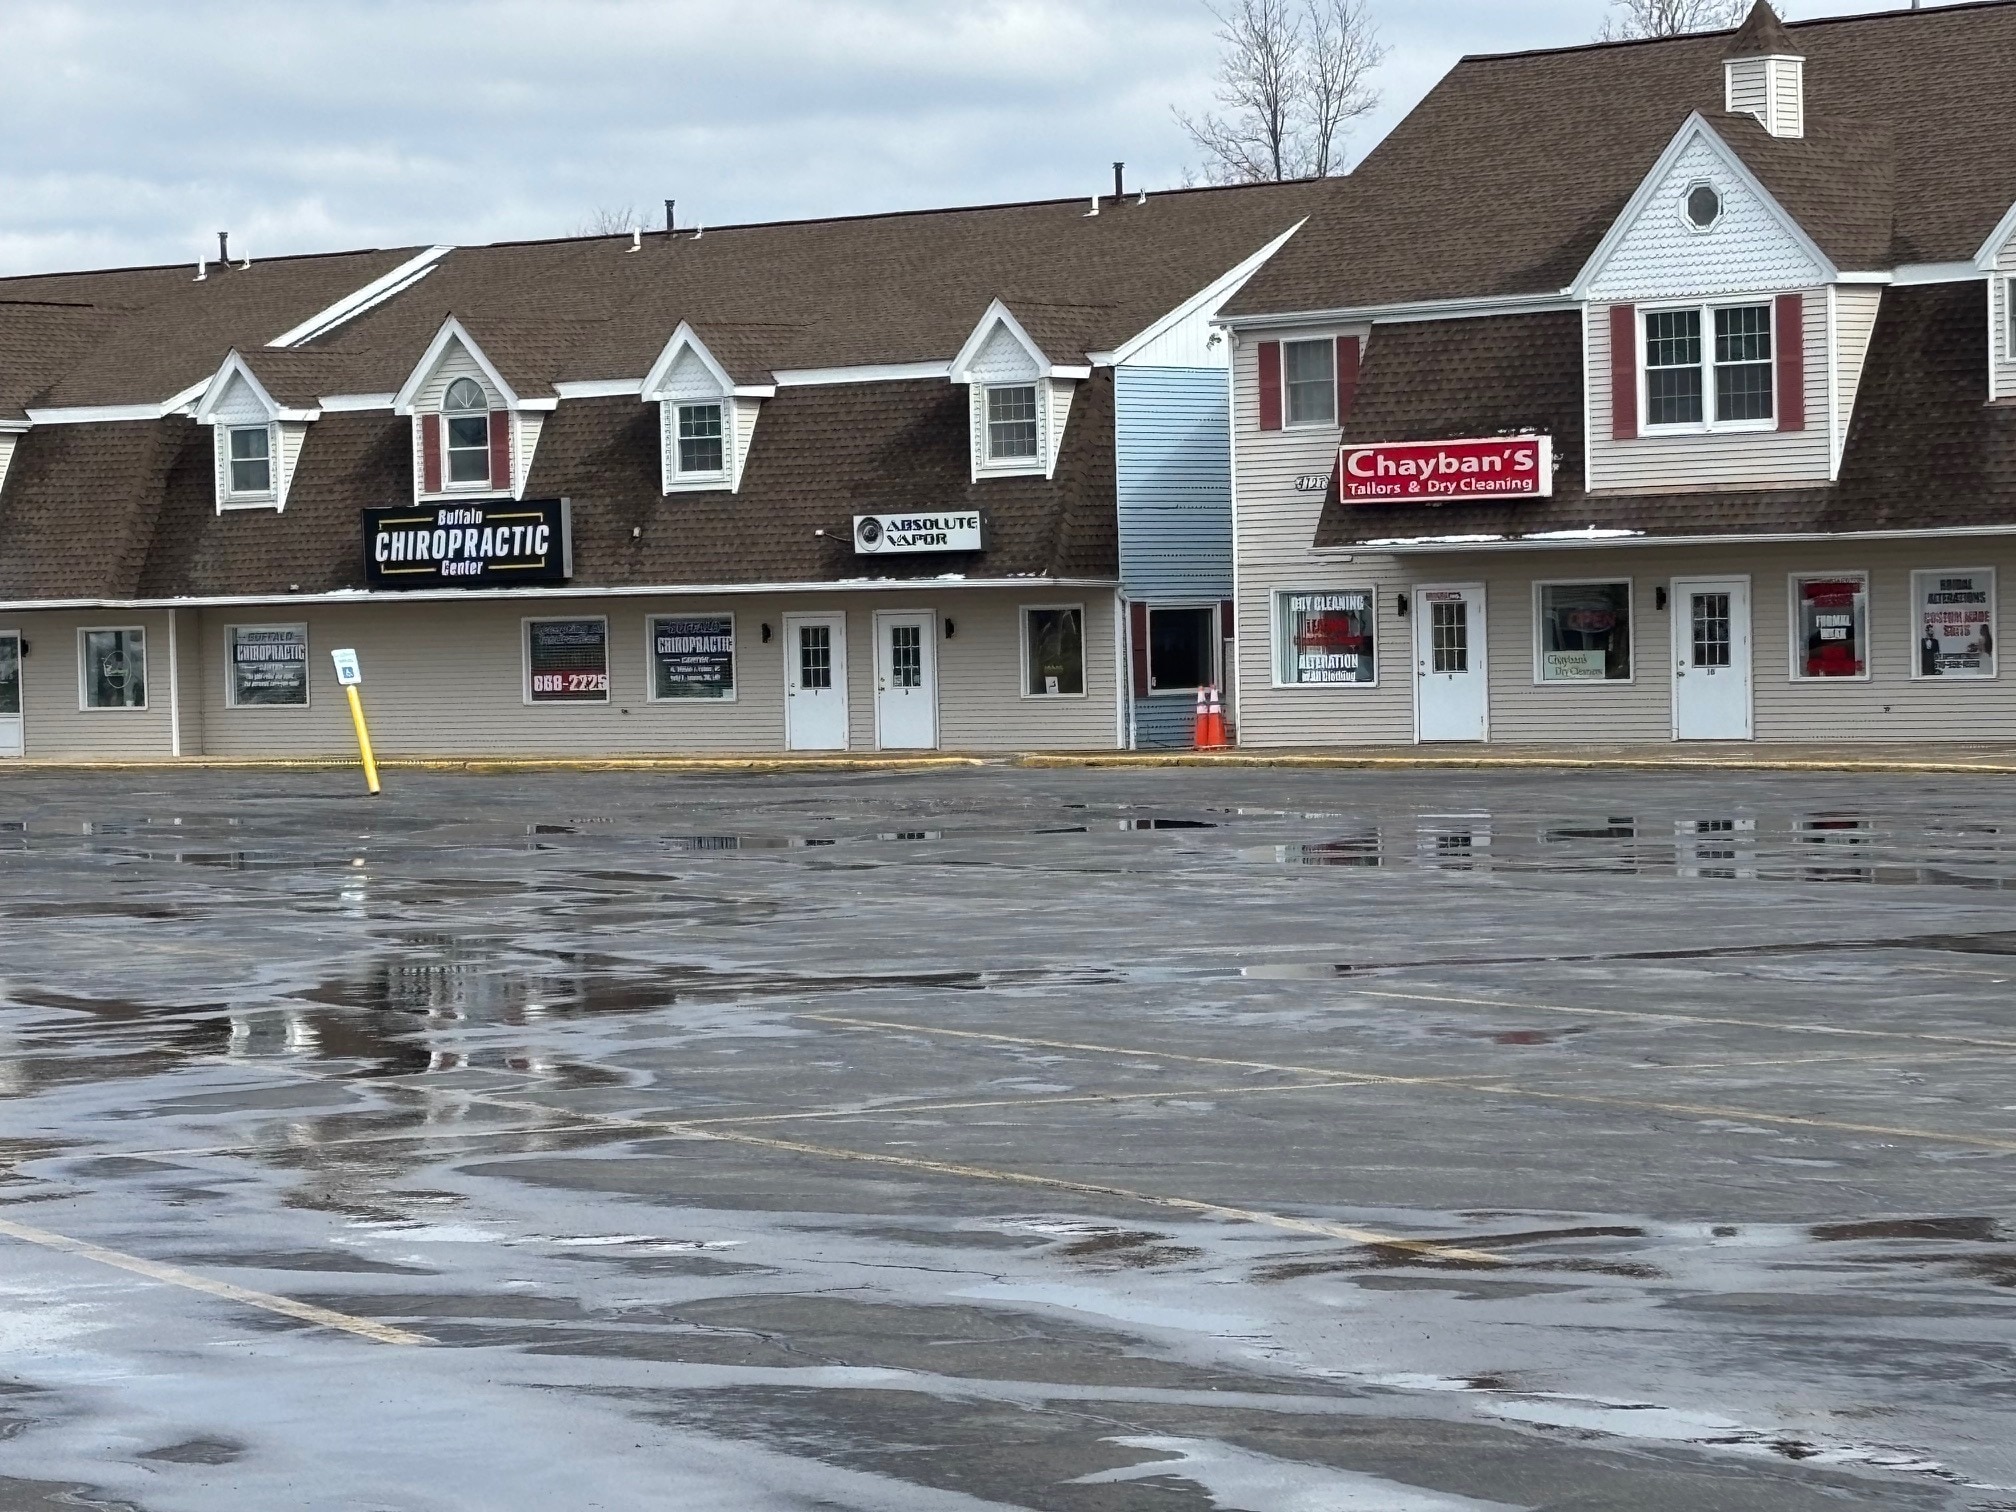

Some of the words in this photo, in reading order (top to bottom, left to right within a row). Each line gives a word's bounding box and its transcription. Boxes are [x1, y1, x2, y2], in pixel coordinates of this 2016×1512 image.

[1348, 481, 1401, 496] Tailors
[1408, 482, 1421, 493] &
[1428, 479, 1457, 496] Dry
[1460, 477, 1533, 492] Cleaning
[437, 507, 483, 526] Buffalo
[885, 516, 978, 532] ABSOLUTE
[374, 524, 550, 562] CHIROPRACTIC
[886, 532, 948, 547] VAPOR
[441, 560, 484, 576] Center
[1314, 595, 1364, 611] CLEANING
[247, 631, 294, 642] BUFFALO
[657, 635, 734, 654] CHIROPRACTIC
[237, 644, 305, 661] CHIROPRACTIC
